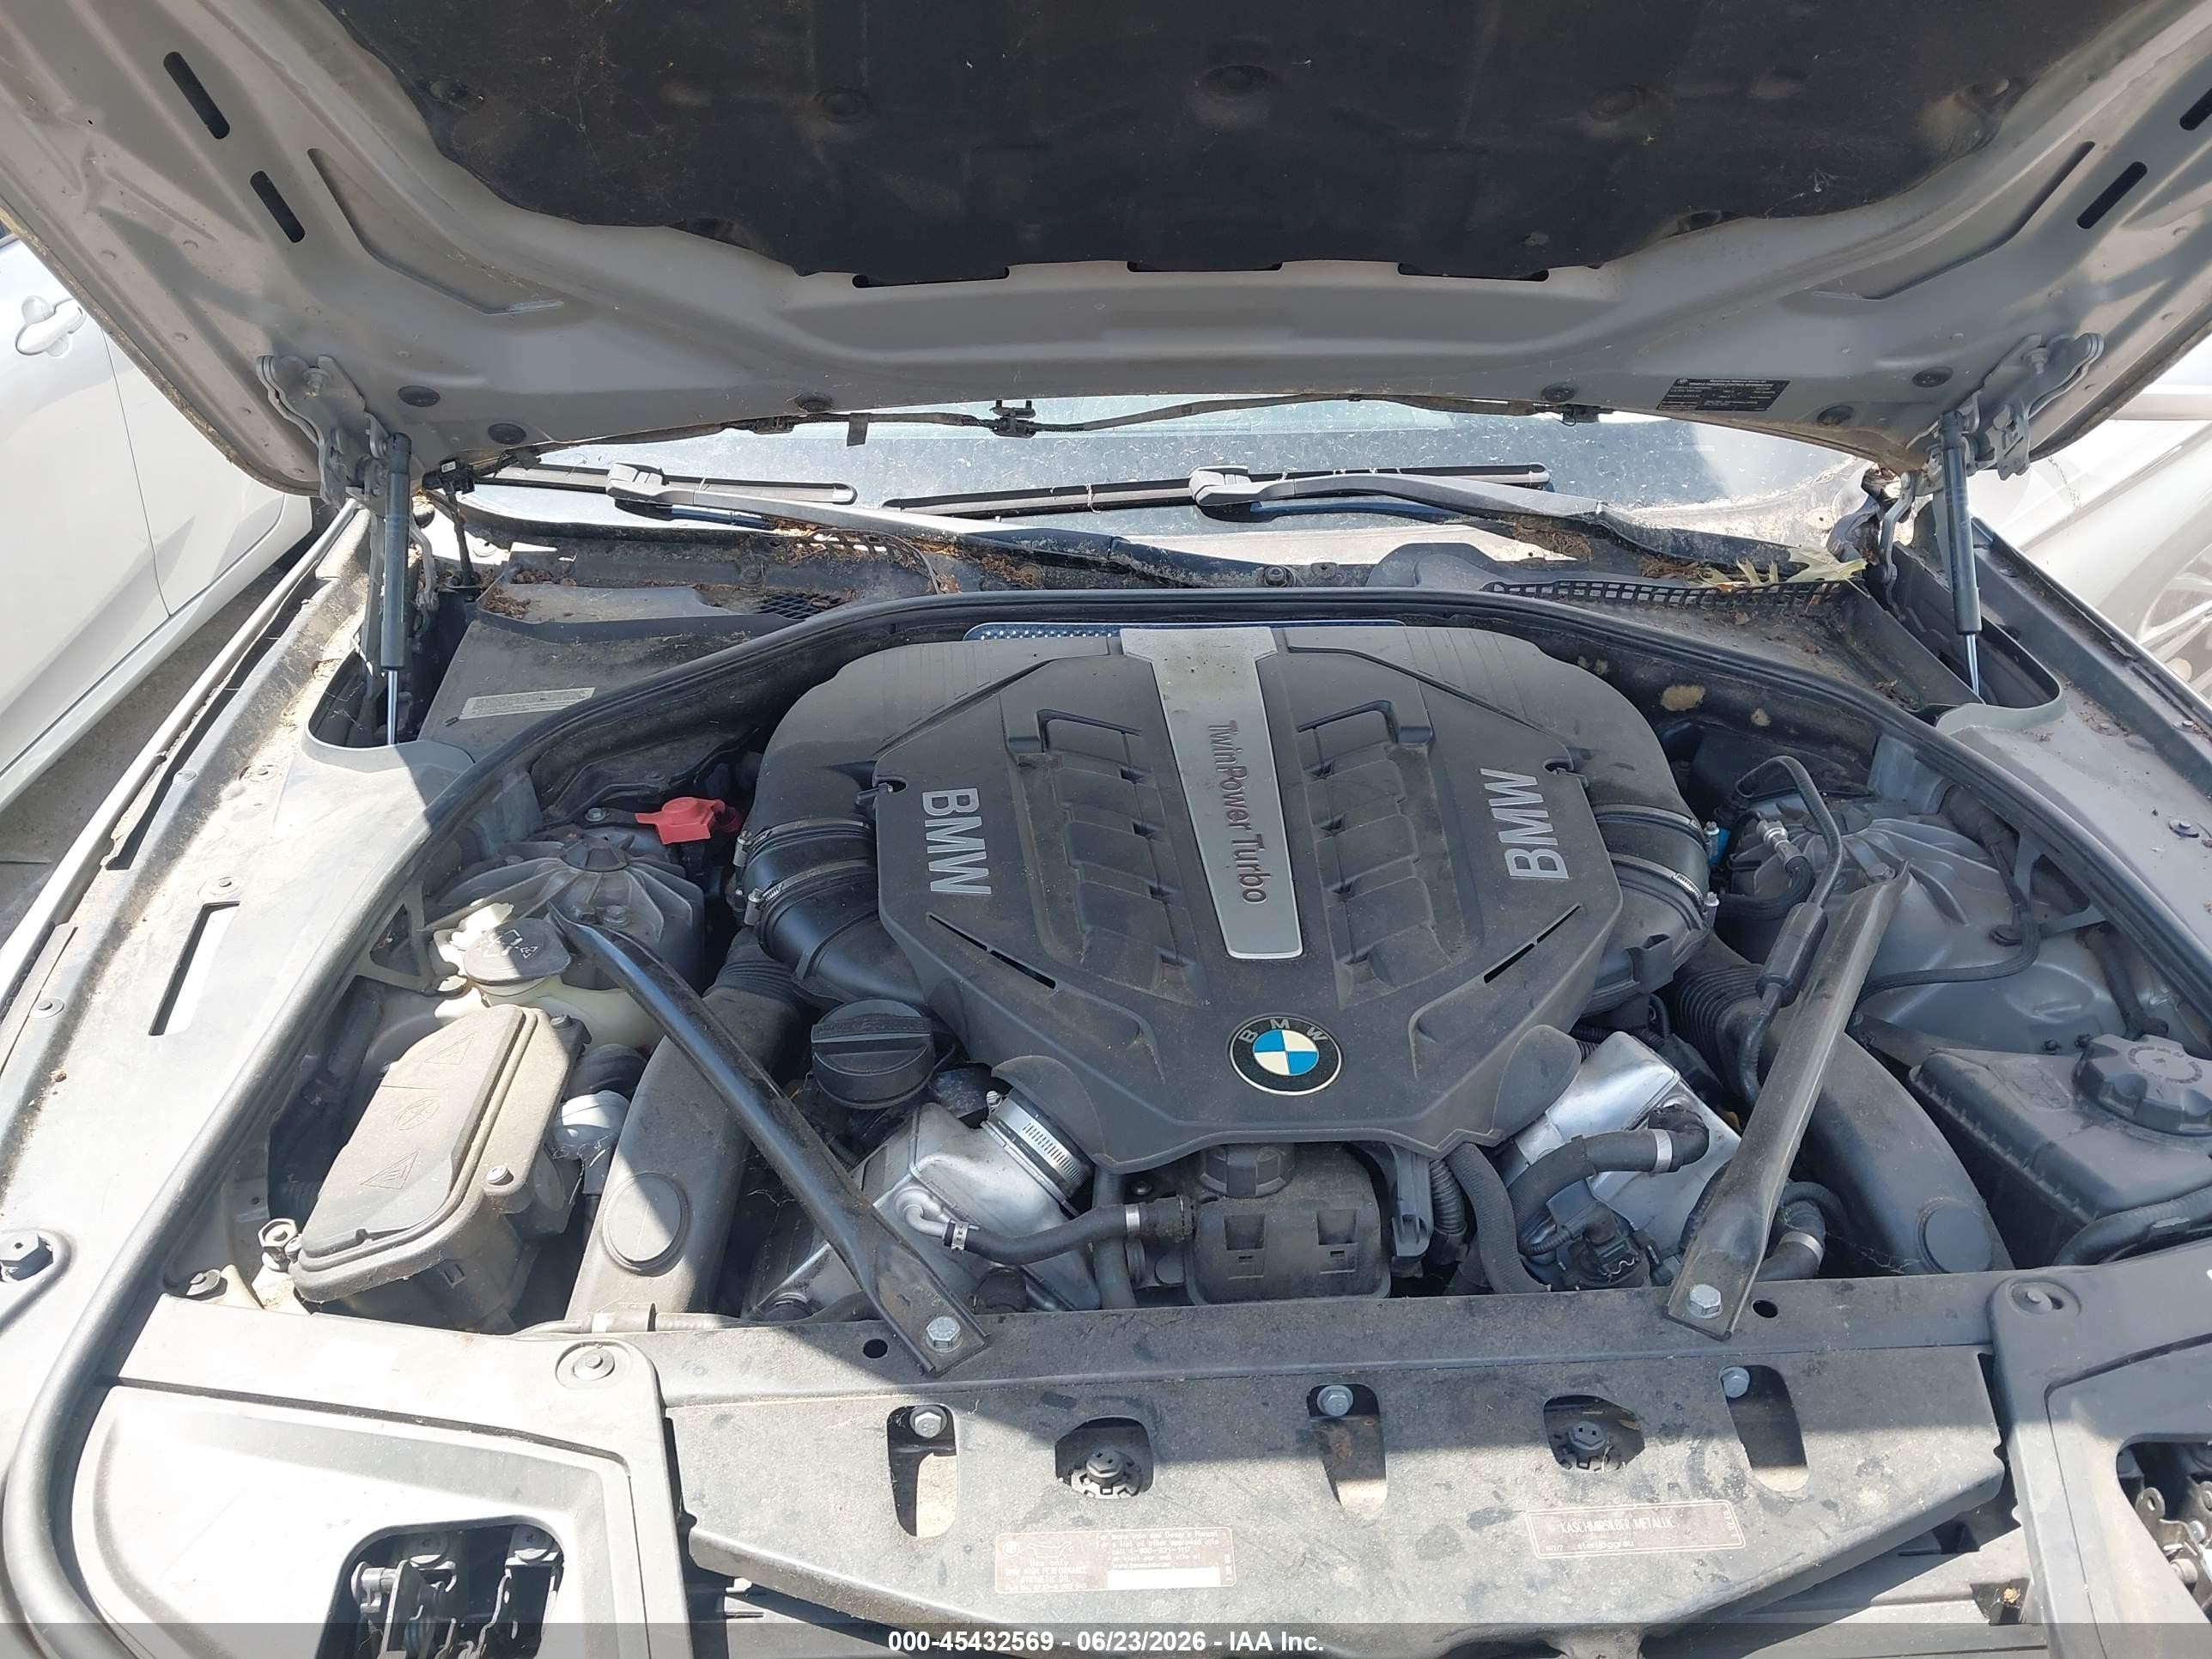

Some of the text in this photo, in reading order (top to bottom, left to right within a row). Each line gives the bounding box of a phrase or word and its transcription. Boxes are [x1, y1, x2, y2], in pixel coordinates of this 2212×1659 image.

[922, 787, 992, 895] BMW
[1208, 720, 1272, 904] TwinPower Turbo
[1480, 768, 1569, 879] BMW
[1238, 1018, 1328, 1043] BMW
[1633, 1516, 1676, 1530] METALLIC
